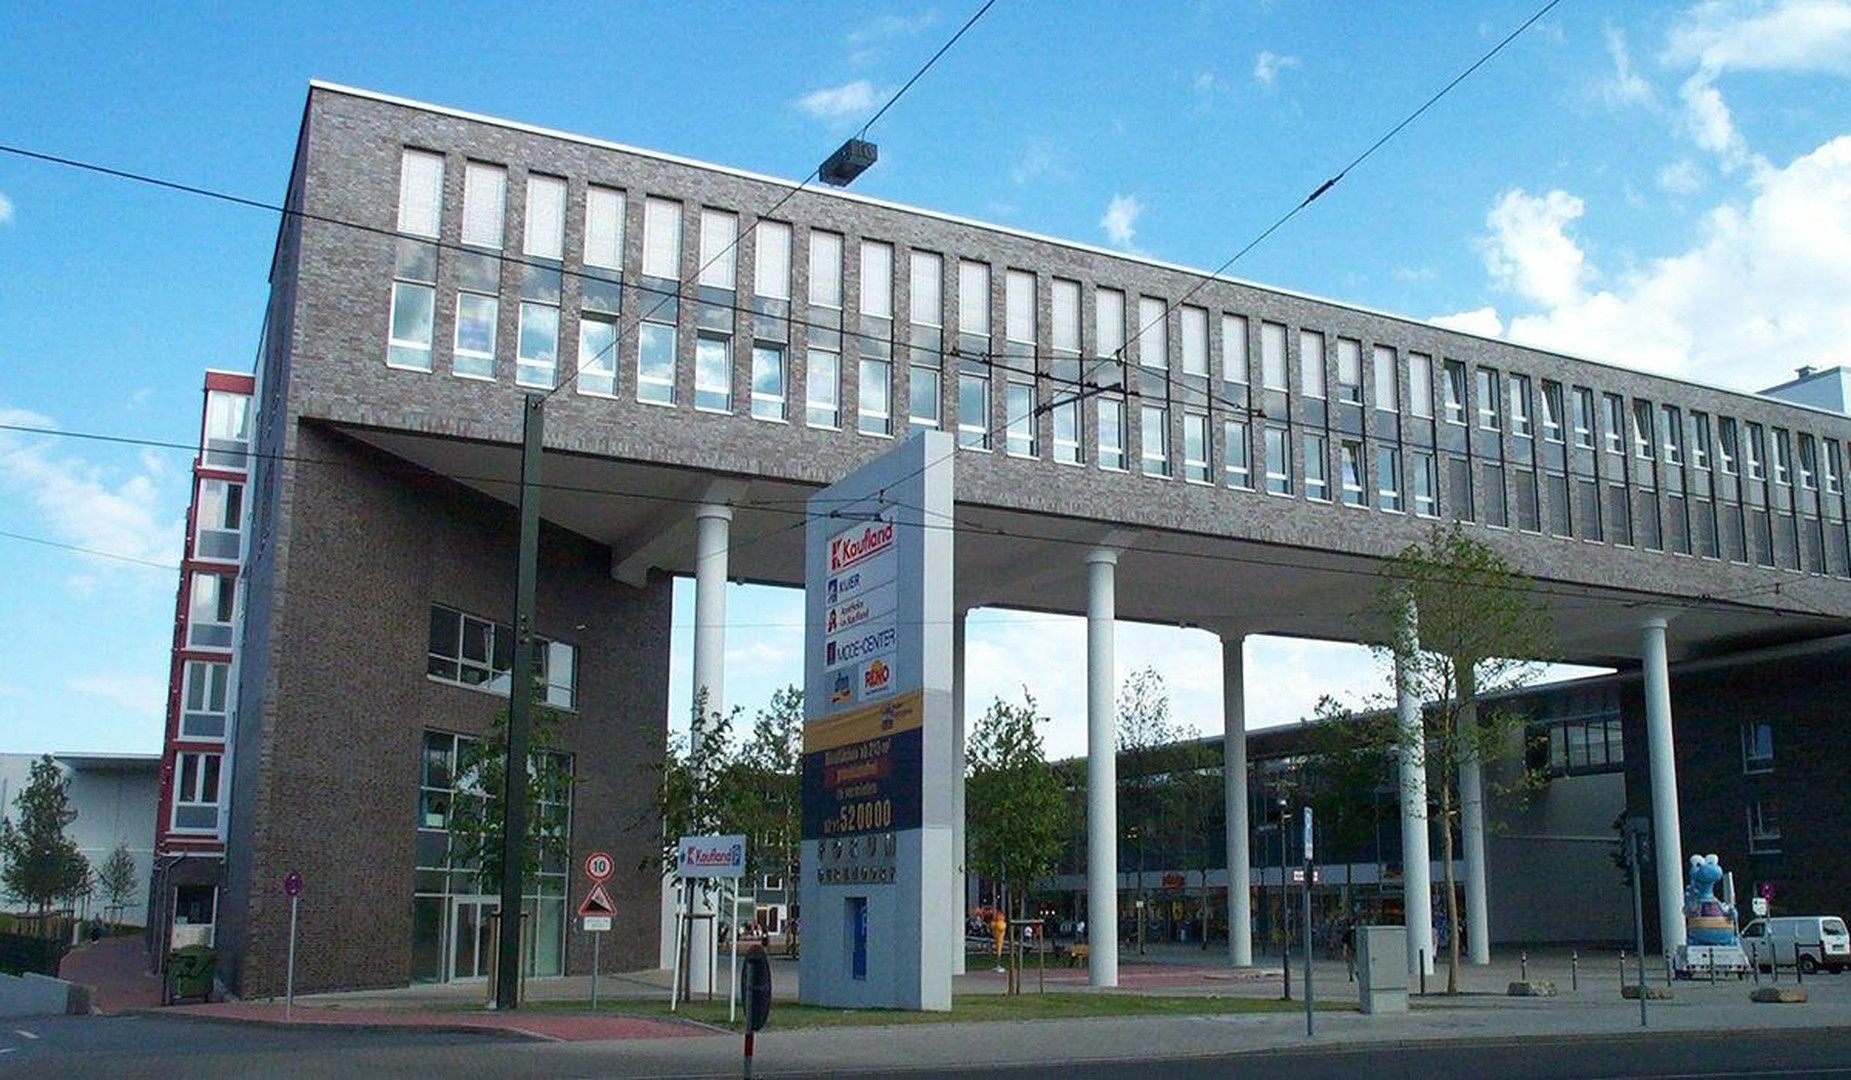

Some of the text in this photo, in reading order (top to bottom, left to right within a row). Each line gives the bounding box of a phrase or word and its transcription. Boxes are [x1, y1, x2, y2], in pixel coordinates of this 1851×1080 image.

[842, 518, 894, 560] Kaufland
[864, 664, 890, 689] RENO
[593, 859, 606, 873] 10
[696, 847, 732, 864] Kaufland
